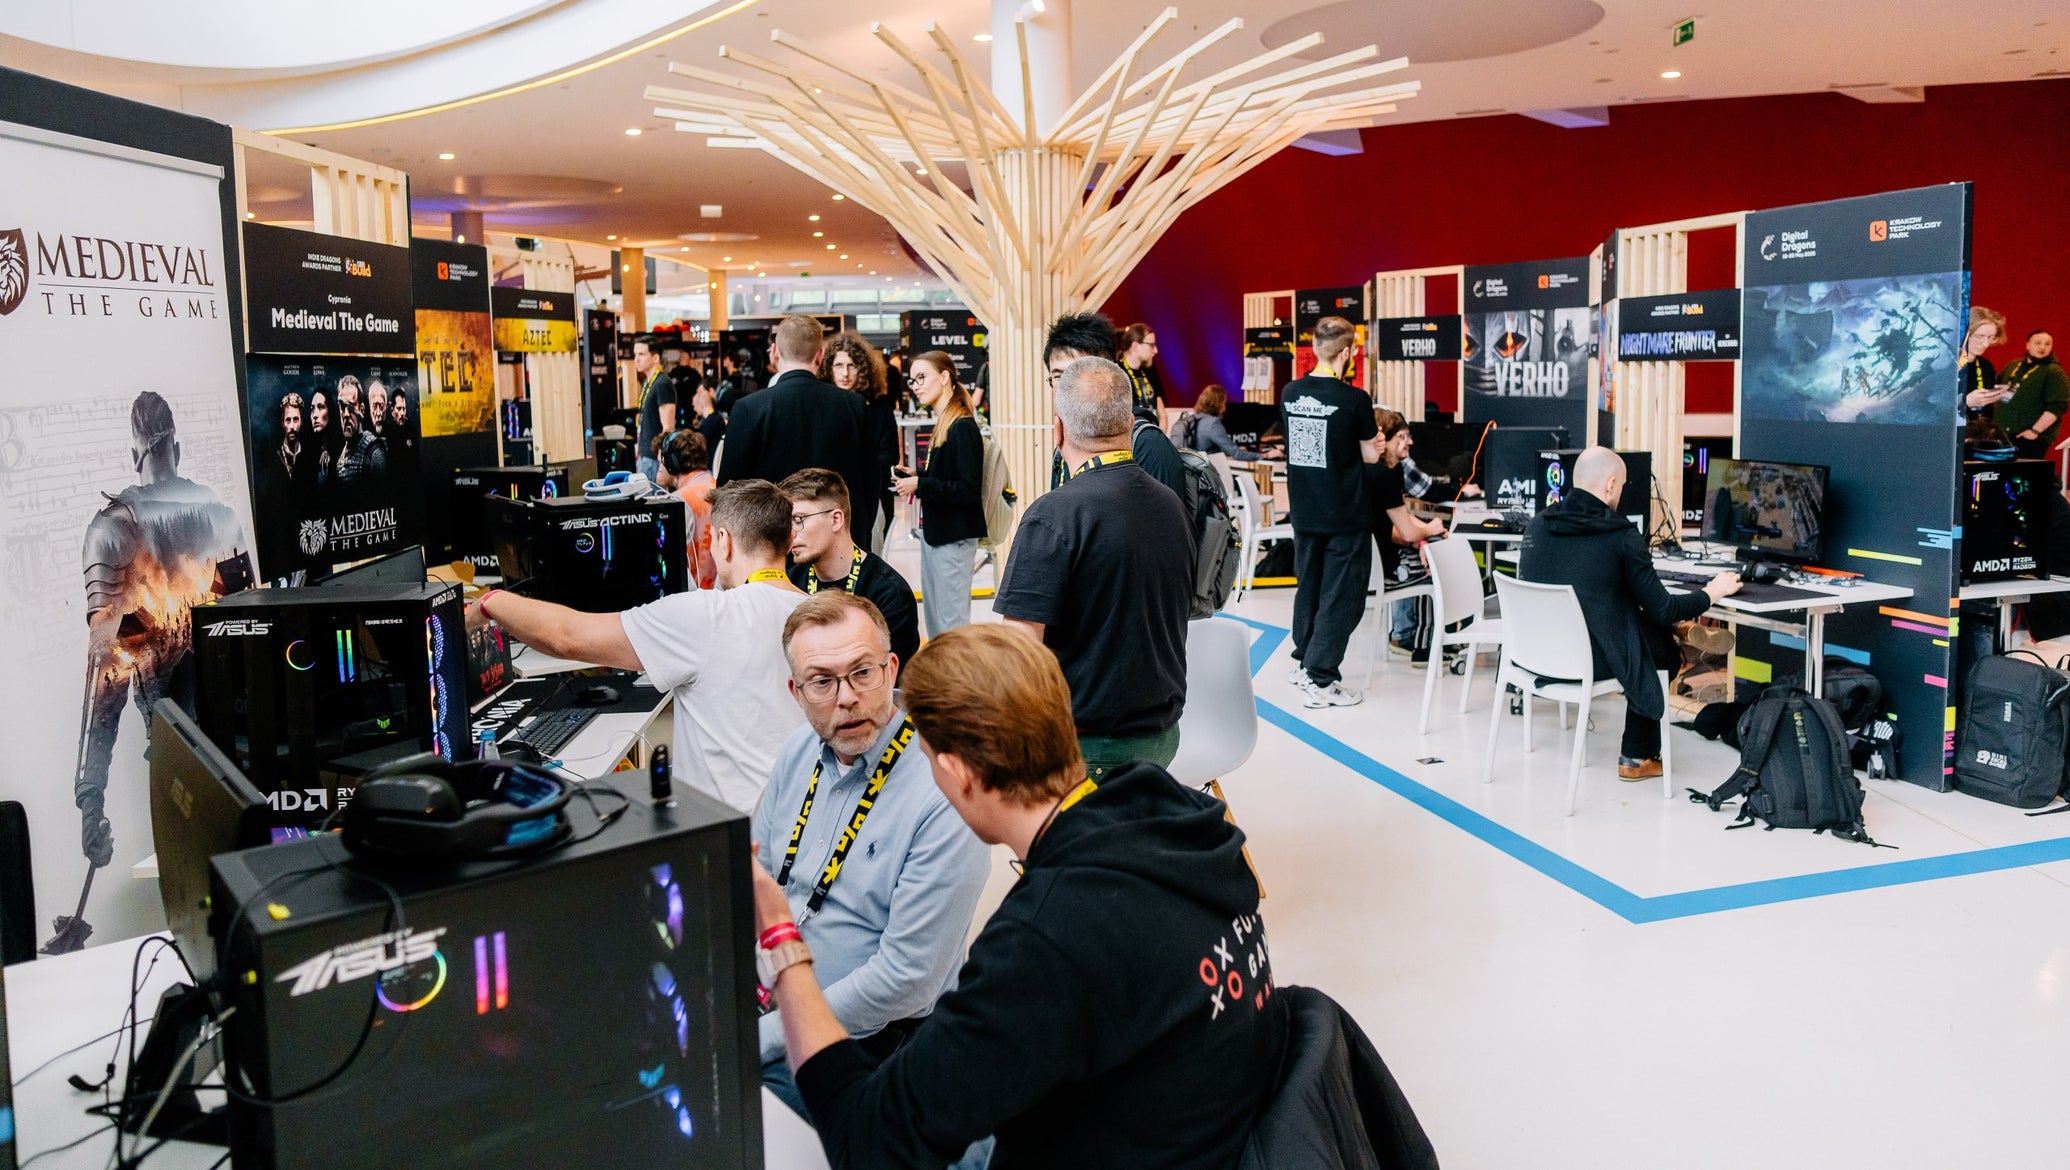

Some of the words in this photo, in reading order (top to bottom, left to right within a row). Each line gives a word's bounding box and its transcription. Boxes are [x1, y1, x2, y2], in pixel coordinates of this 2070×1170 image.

[1890, 217, 1922, 226] KRAKOW
[1890, 221, 1942, 232] TECHNOLOGY
[1781, 230, 1809, 243] Digital
[1781, 240, 1817, 252] Dragons
[37, 231, 214, 287] MEDIEVAL
[307, 253, 320, 261] INDIE
[320, 255, 342, 264] DRAGONS
[302, 261, 321, 270] AWARDS
[322, 263, 342, 272] PARTNER
[41, 292, 113, 316] THE
[139, 296, 218, 319] GAME
[327, 294, 351, 304] Cypronia
[271, 307, 337, 330] Medieval
[339, 311, 363, 331] The
[365, 313, 399, 333] Game
[523, 329, 552, 346] AZTEC
[931, 335, 968, 346] LEVEL
[1620, 331, 1675, 356] NIGHTMARE
[1675, 329, 1717, 354] FRONTIER
[1401, 337, 1437, 357] VERHO
[1494, 361, 1570, 398] VERHO
[1293, 405, 1311, 413] SCAN
[1230, 433, 1249, 443] MD
[330, 508, 397, 537] MEDIEVAL
[330, 537, 359, 551] THE
[366, 530, 396, 545] GAME
[1973, 560, 2000, 572] AMD
[202, 622, 273, 637] ASUS
[259, 790, 302, 811] MD
[274, 927, 447, 997] ASUS
